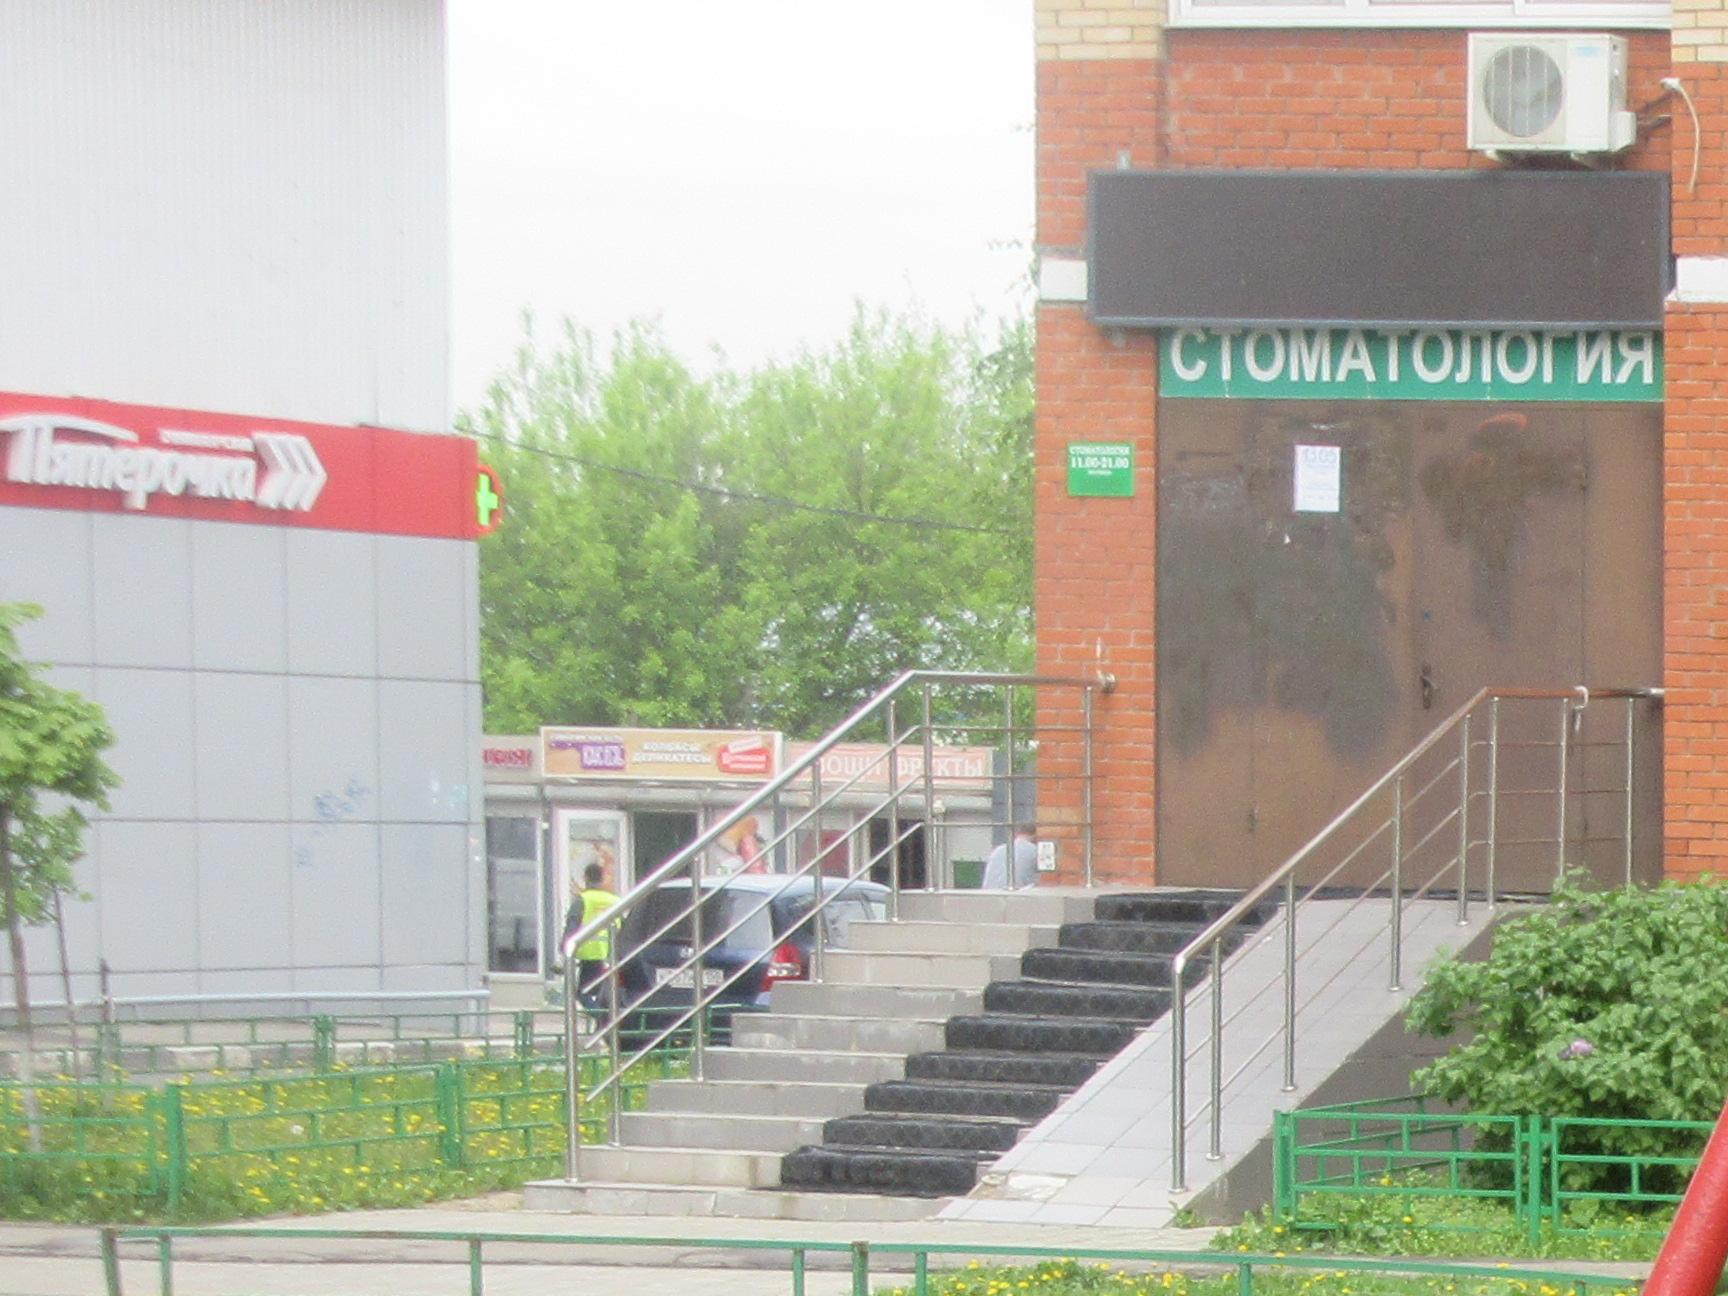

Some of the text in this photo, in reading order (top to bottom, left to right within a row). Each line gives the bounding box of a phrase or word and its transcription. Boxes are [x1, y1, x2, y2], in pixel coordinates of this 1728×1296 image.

[1170, 328, 1655, 384] СТОМАТОЛОГИЯ
[812, 754, 983, 776] ОЩИ ФРКТЫ
